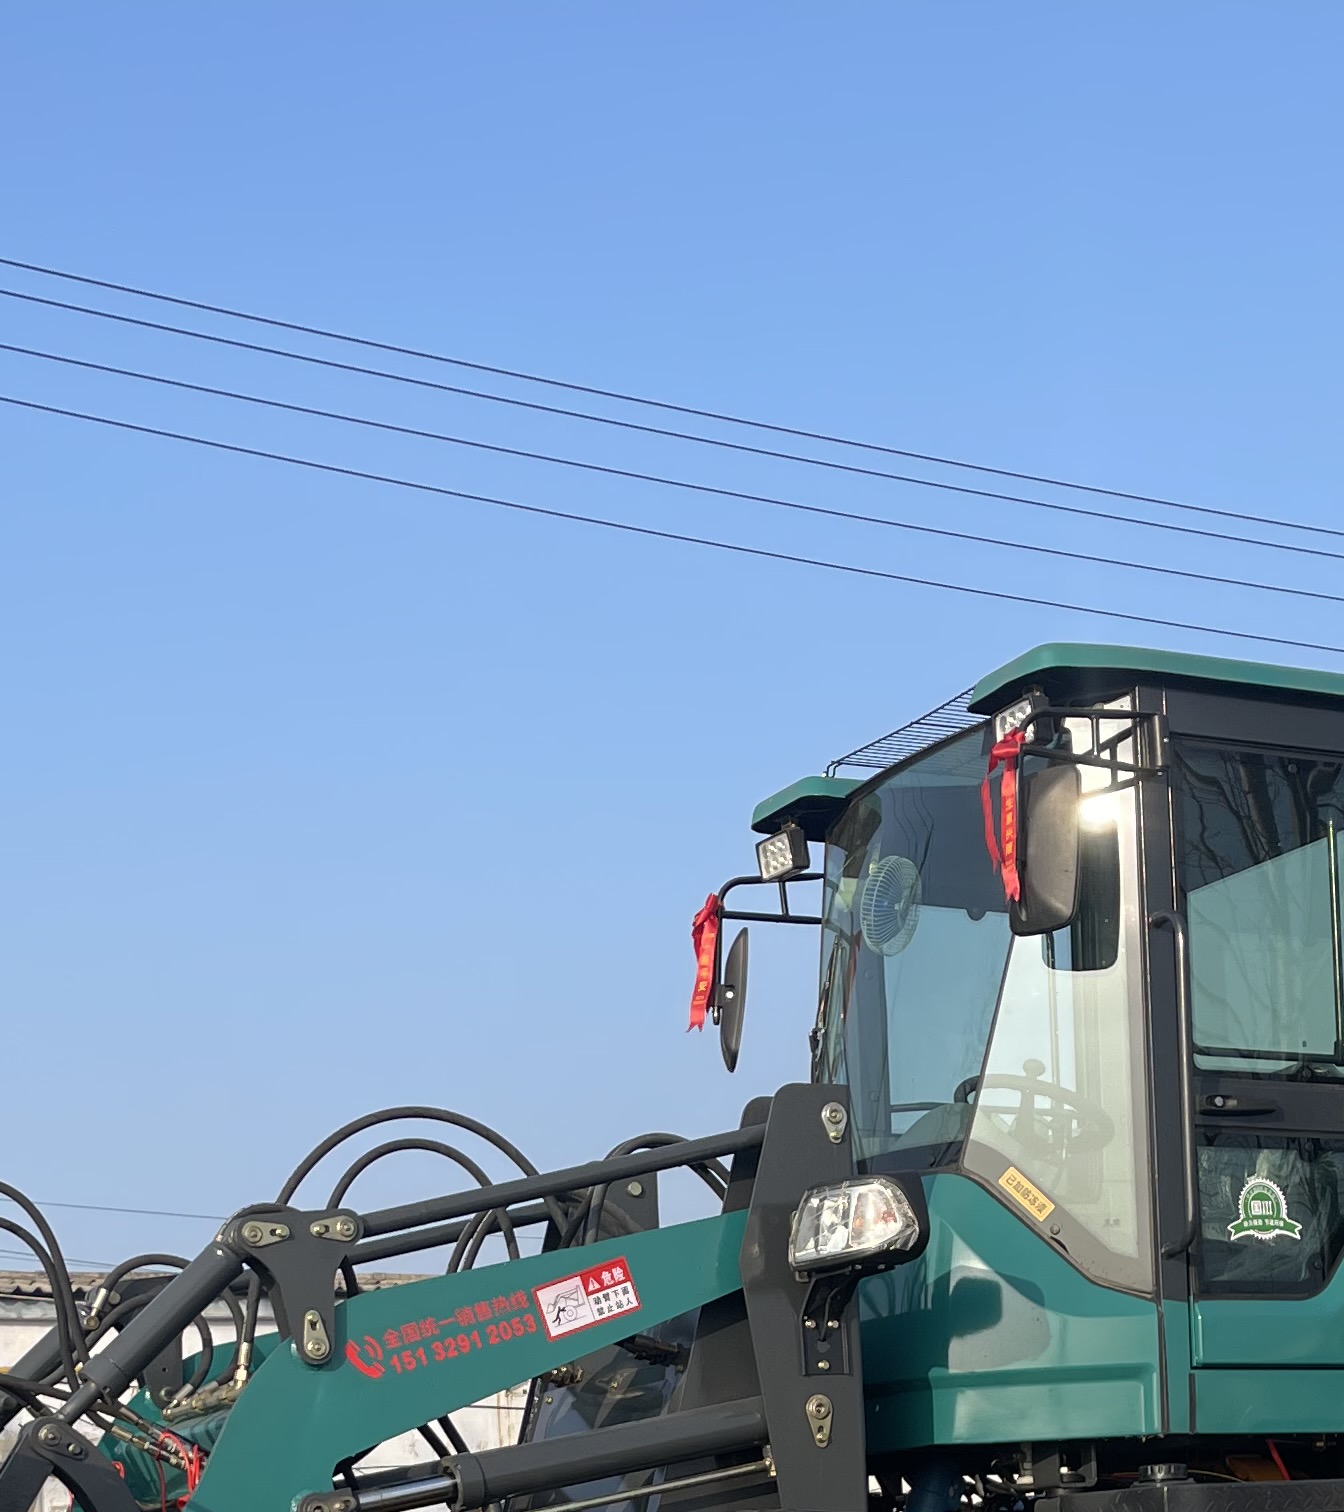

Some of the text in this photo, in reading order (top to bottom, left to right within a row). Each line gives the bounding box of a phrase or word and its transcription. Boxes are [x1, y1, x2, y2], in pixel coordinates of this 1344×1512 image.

[1005, 1174, 1047, 1214] 已加防冻液
[601, 1266, 626, 1287] 危险
[593, 1286, 630, 1305] 动臂下面
[596, 1296, 634, 1317] 禁止站人
[382, 1290, 529, 1349] 全国统一销售热线
[390, 1314, 537, 1374] 151 3291 2053
